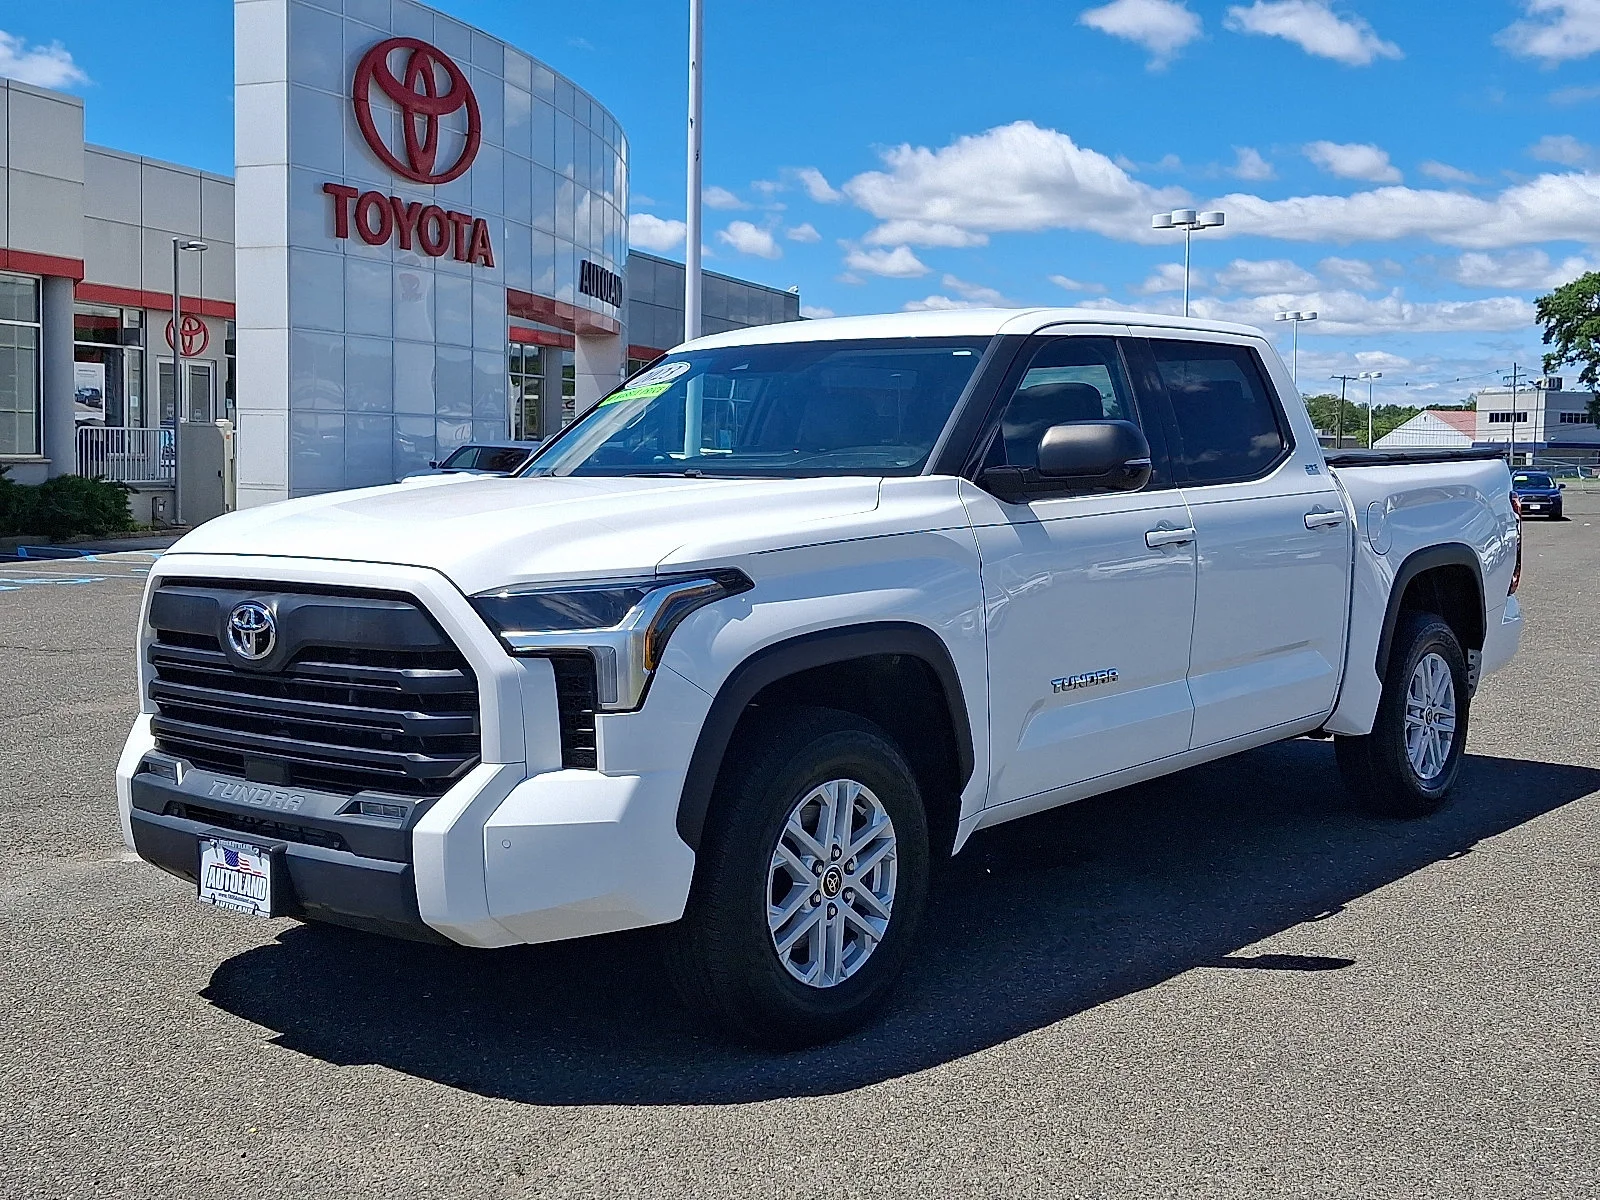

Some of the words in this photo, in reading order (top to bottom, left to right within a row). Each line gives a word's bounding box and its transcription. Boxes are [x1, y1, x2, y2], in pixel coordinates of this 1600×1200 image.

[323, 182, 495, 268] TOYOTA
[1050, 667, 1119, 694] TUNDRA
[208, 780, 306, 812] TUNDRA
[206, 865, 268, 901] AUTOLAND
[214, 899, 254, 915] AUTOLAND
